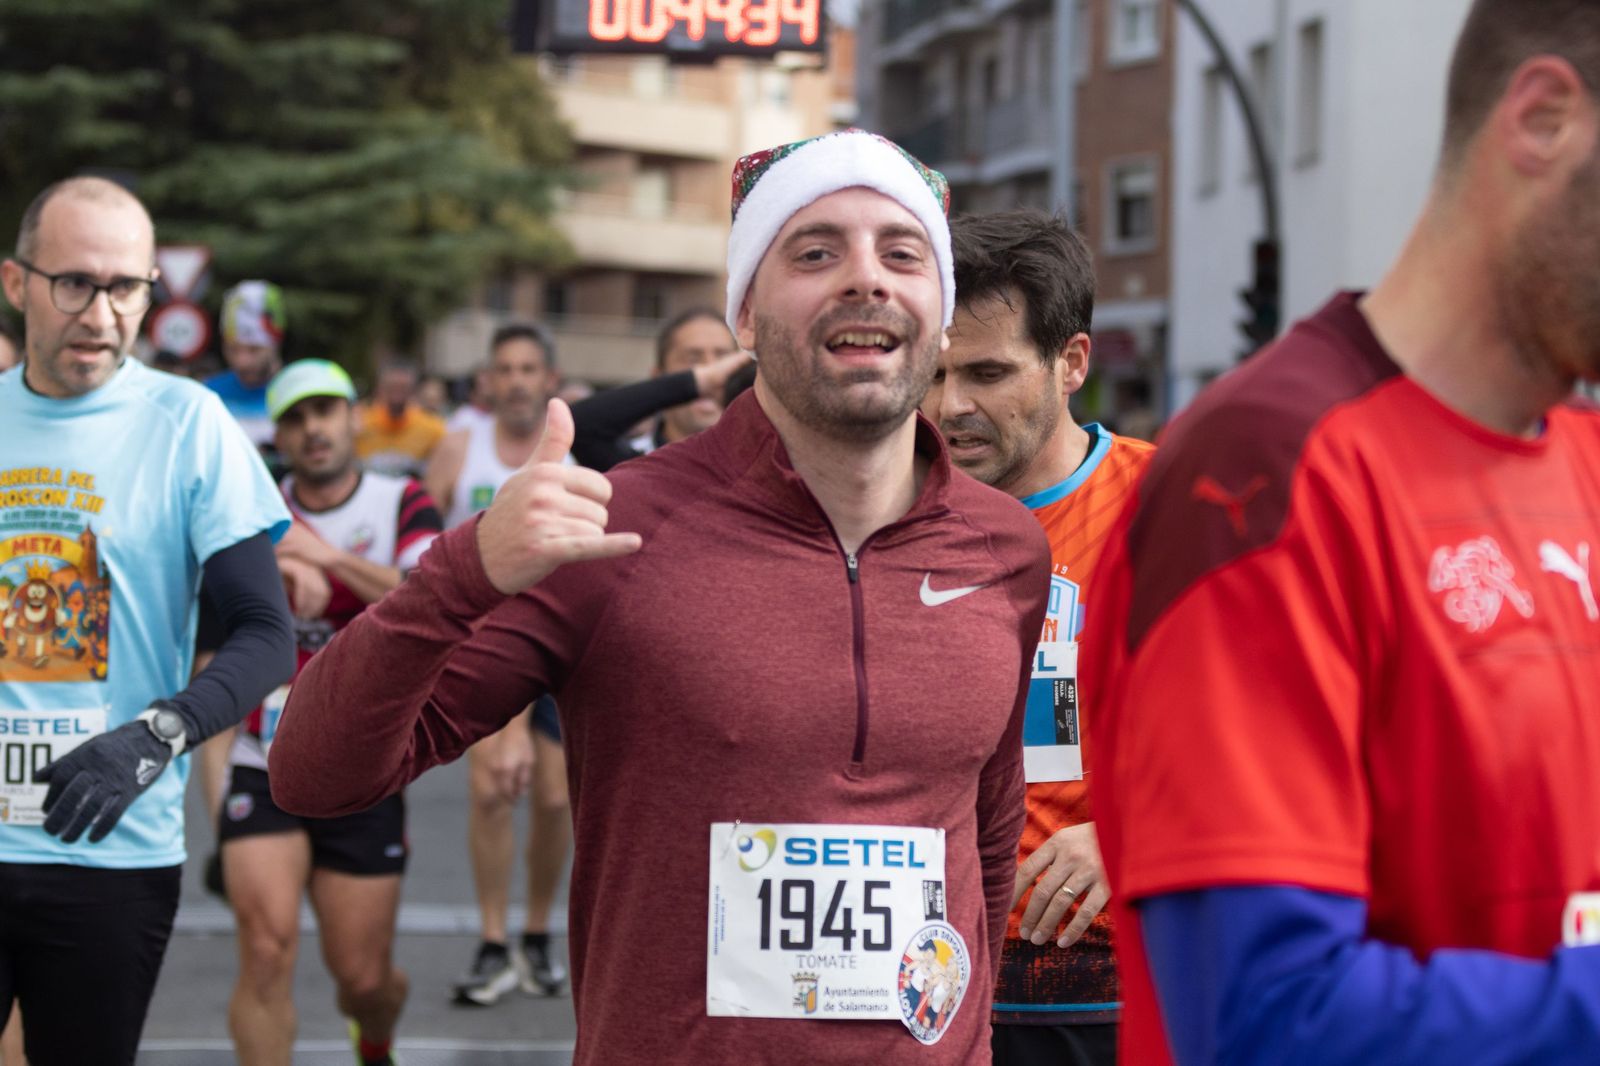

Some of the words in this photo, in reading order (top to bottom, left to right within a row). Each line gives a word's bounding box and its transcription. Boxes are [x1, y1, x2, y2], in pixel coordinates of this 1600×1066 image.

[0, 467, 62, 487] ARRERA
[67, 469, 95, 491] DEL
[12, 536, 62, 556] META
[1043, 618, 1058, 642] N
[1067, 684, 1075, 703] 4321
[0, 717, 90, 735] SETEL
[0, 742, 51, 784] 00
[784, 837, 926, 868] SETEL
[757, 878, 892, 952] 1945
[796, 954, 857, 969] TOMATE
[824, 986, 889, 999] Ayuntamiento
[824, 1002, 834, 1012] de
[838, 1002, 889, 1012] Salamanca
